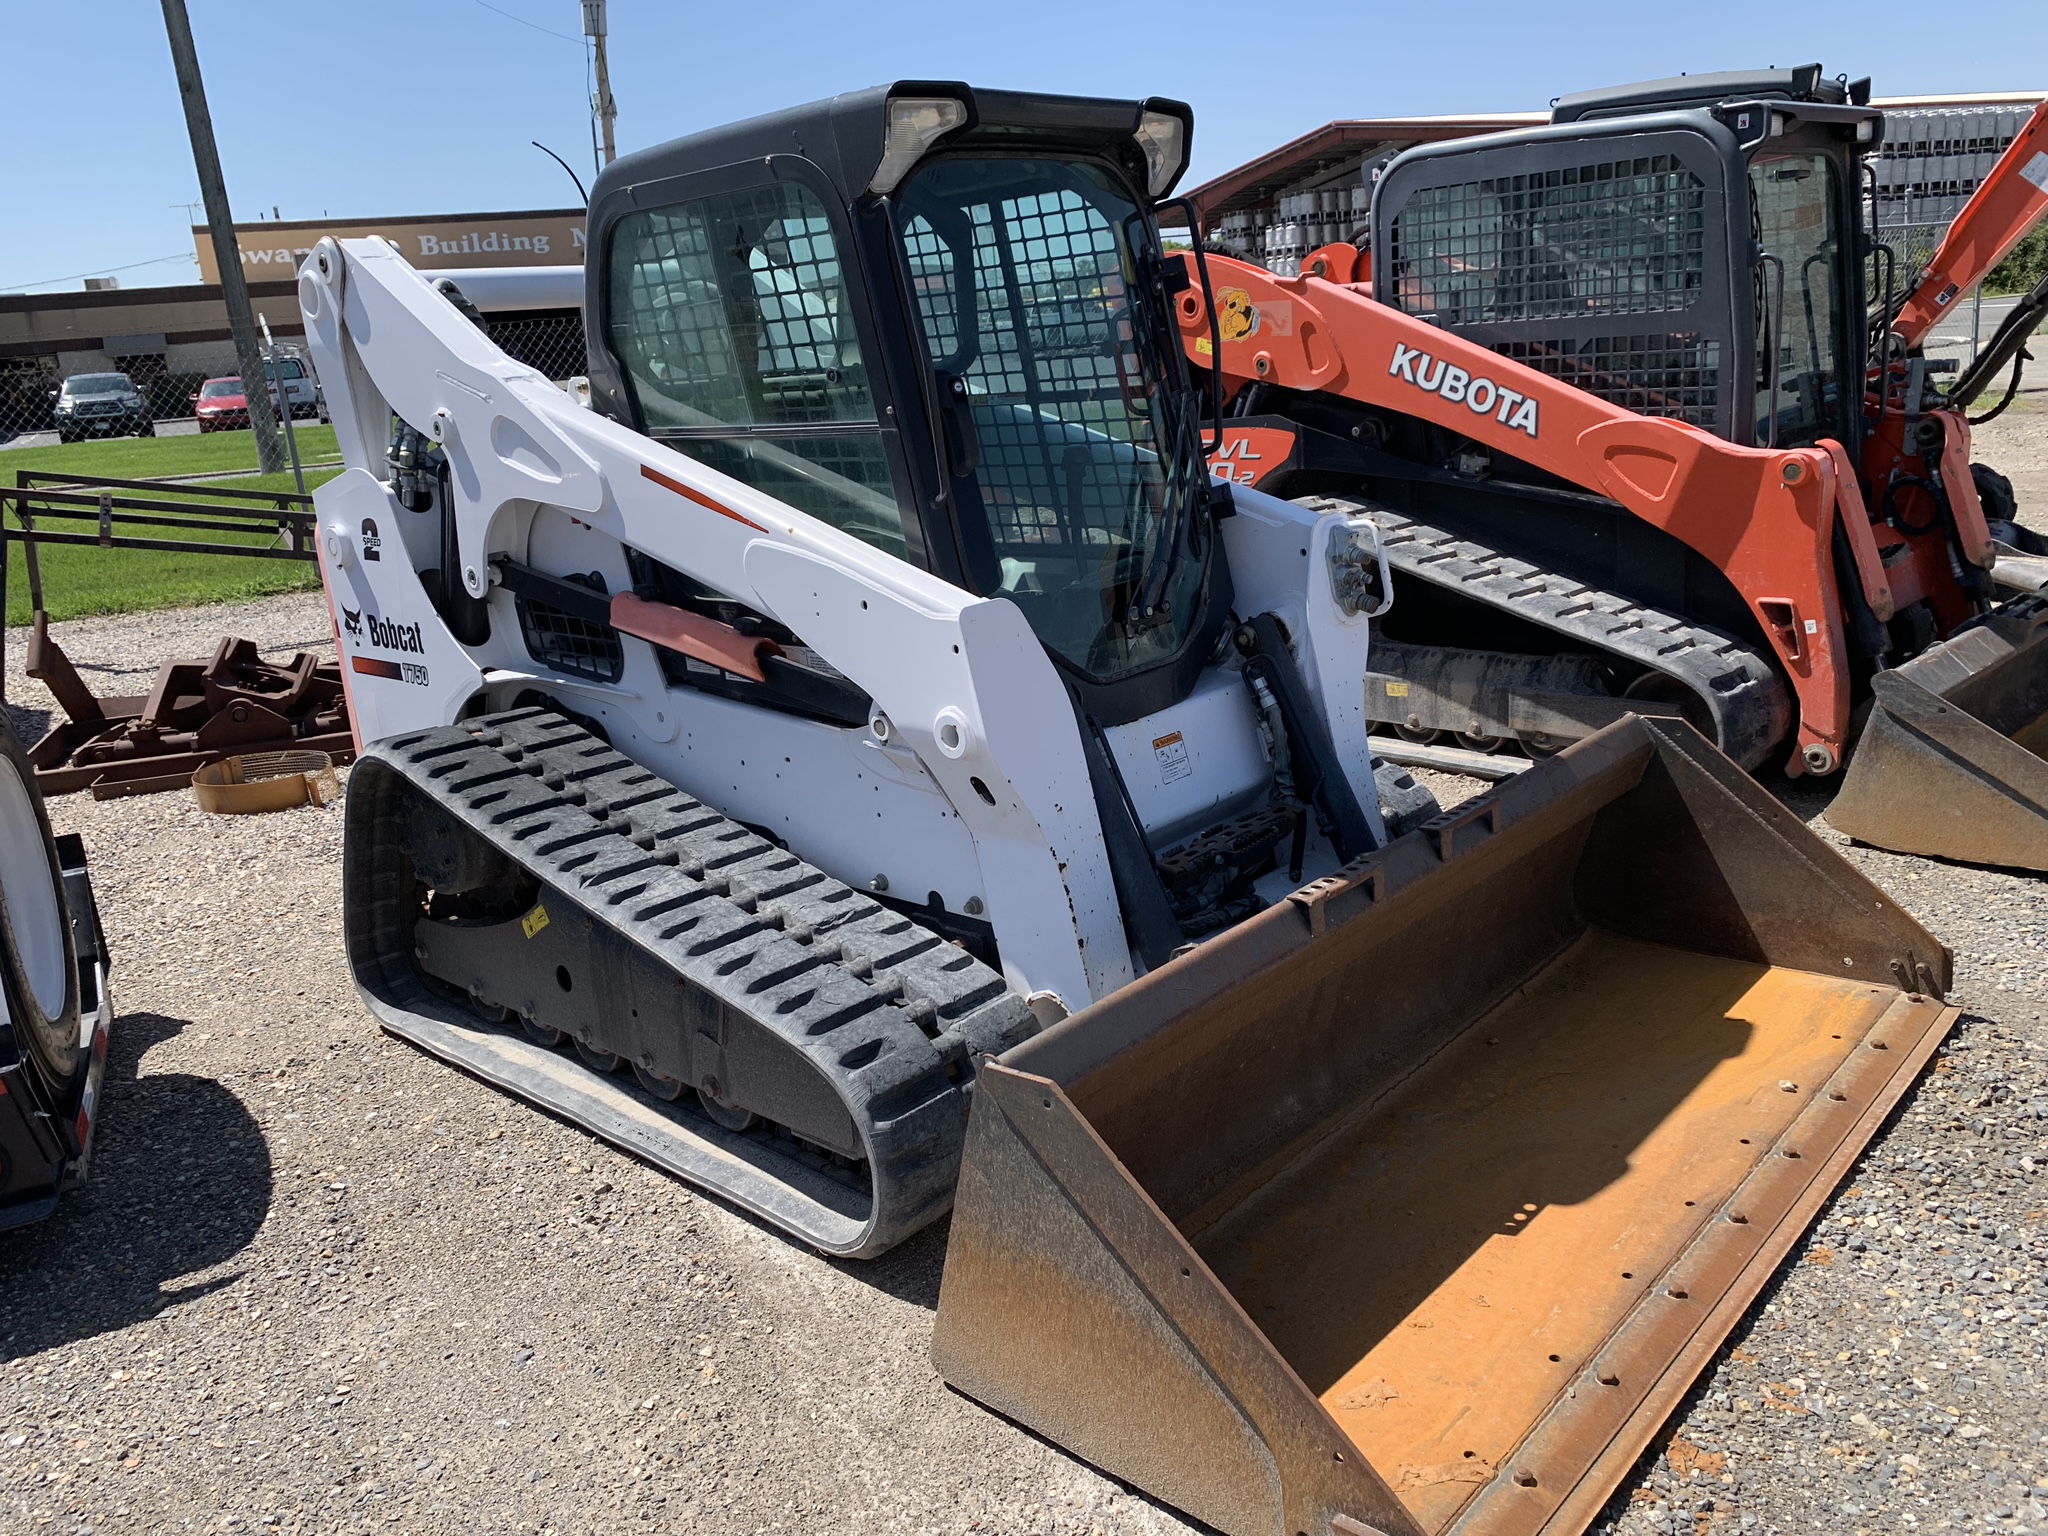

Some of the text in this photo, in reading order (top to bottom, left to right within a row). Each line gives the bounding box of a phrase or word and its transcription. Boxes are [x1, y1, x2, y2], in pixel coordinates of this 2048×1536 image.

[417, 232, 551, 255] Building
[1388, 342, 1538, 438] KUBOTA
[1207, 461, 1255, 486] 0-2
[361, 517, 381, 562] 2
[362, 536, 382, 547] SPEED
[366, 613, 425, 655] Bobcat
[402, 662, 430, 687] T750
